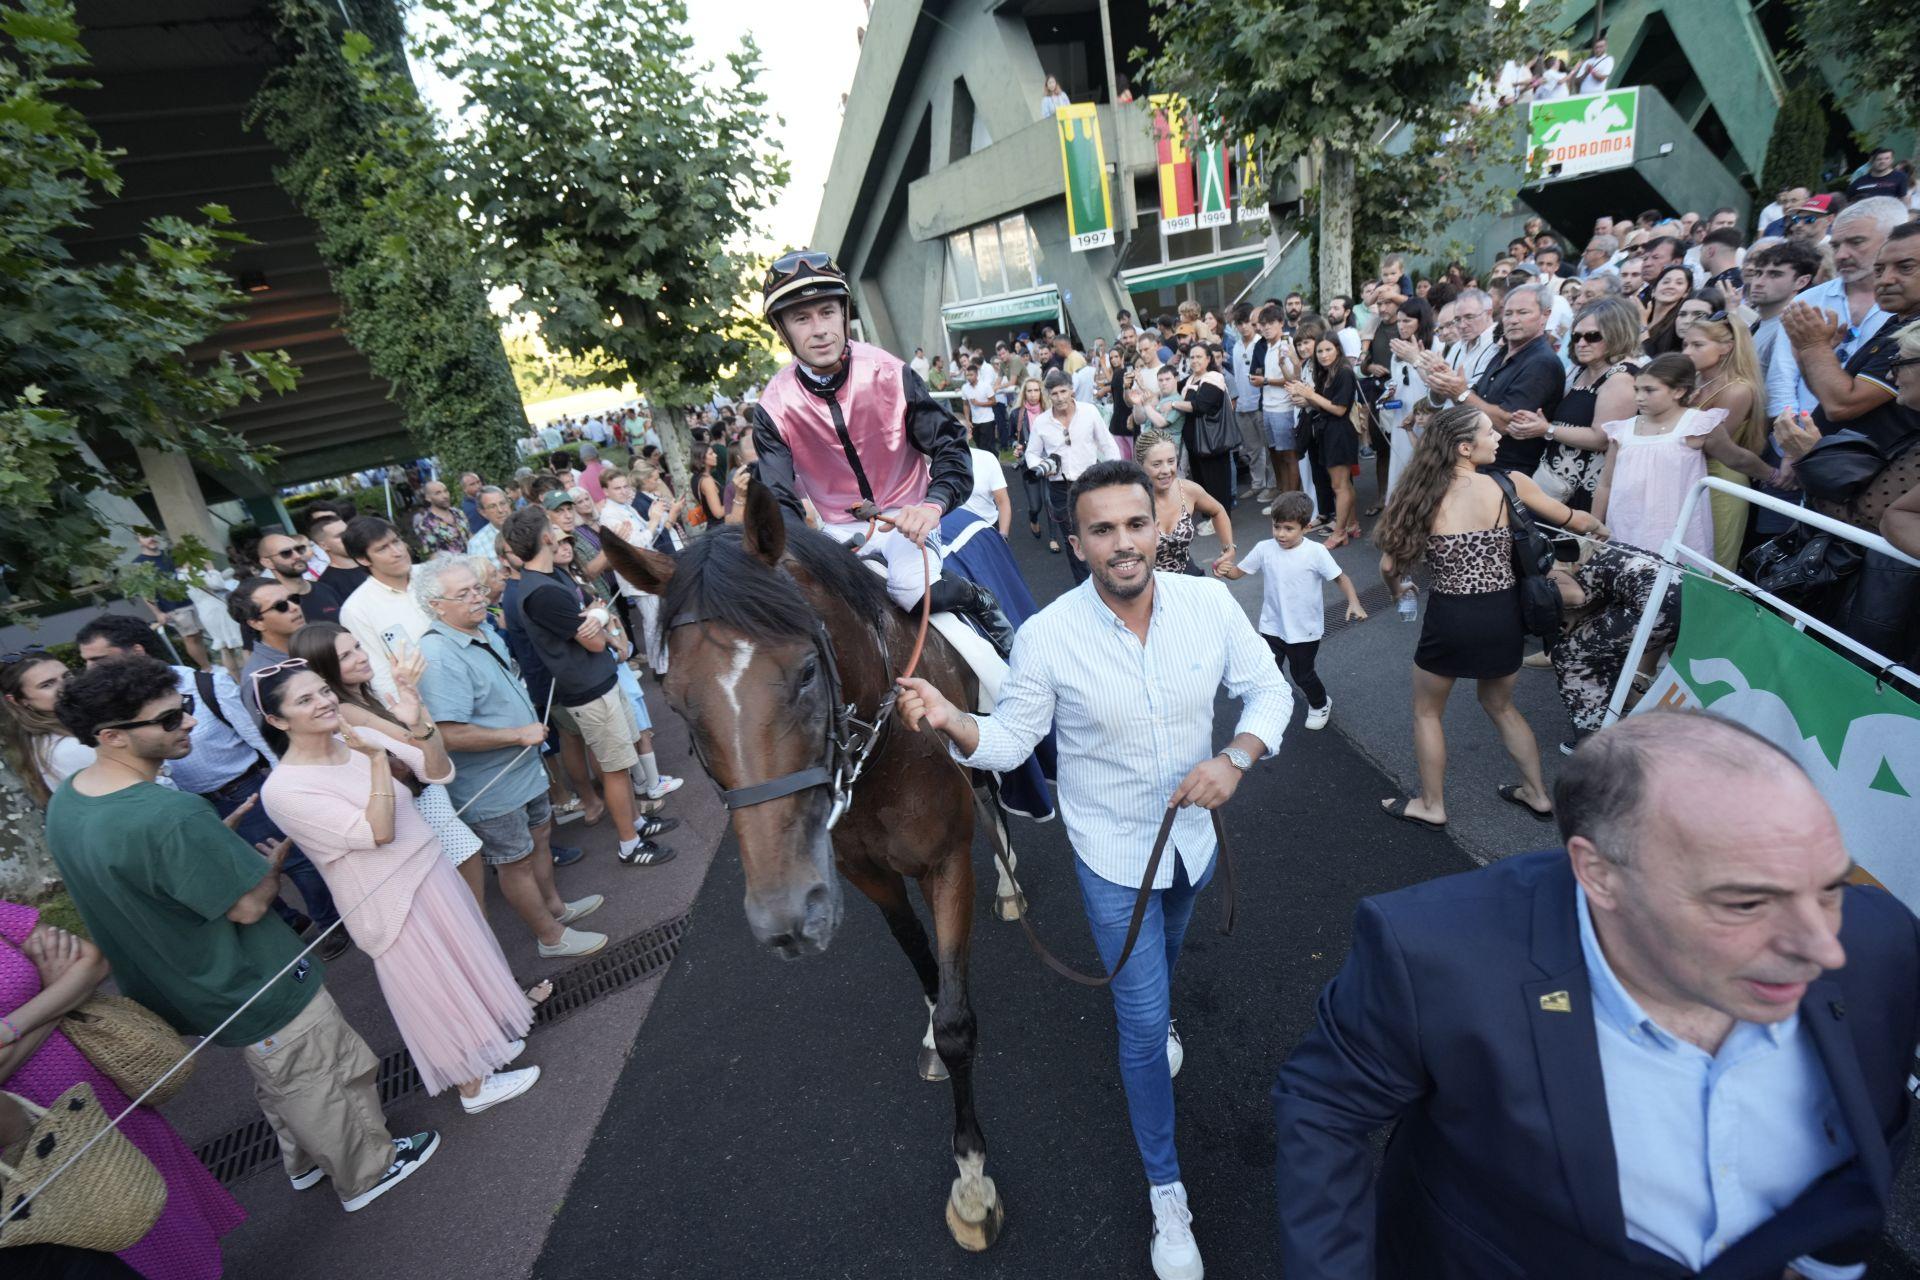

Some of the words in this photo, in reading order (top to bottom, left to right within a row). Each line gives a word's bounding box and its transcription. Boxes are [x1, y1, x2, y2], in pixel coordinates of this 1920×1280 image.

[1203, 211, 1226, 223] 1999
[1167, 218, 1190, 230] 1998
[1077, 232, 1106, 247] 1997
